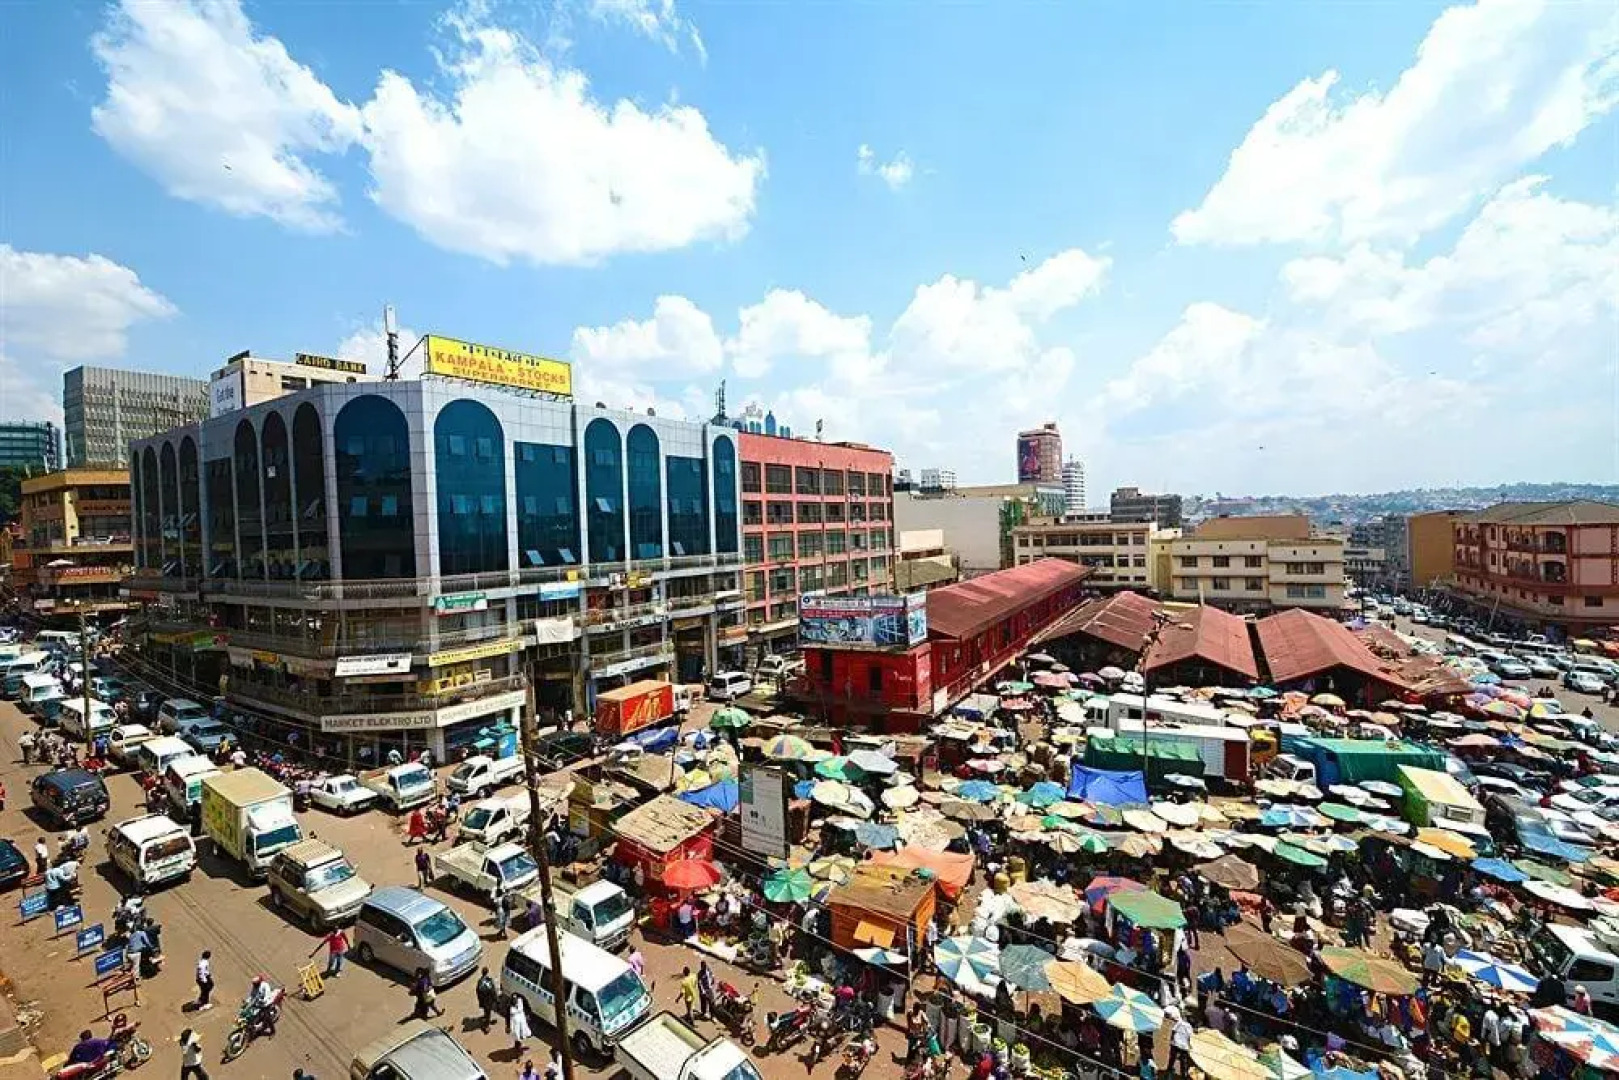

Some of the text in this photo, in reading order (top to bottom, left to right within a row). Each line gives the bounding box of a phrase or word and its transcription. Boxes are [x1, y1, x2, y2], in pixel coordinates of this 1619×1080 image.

[337, 360, 364, 373] BANK
[434, 350, 506, 374] KAMPALA
[517, 367, 567, 385] STOCKS
[452, 366, 552, 389] SUPERMARKET
[325, 715, 431, 729] MARKET ELEKTRO LTD
